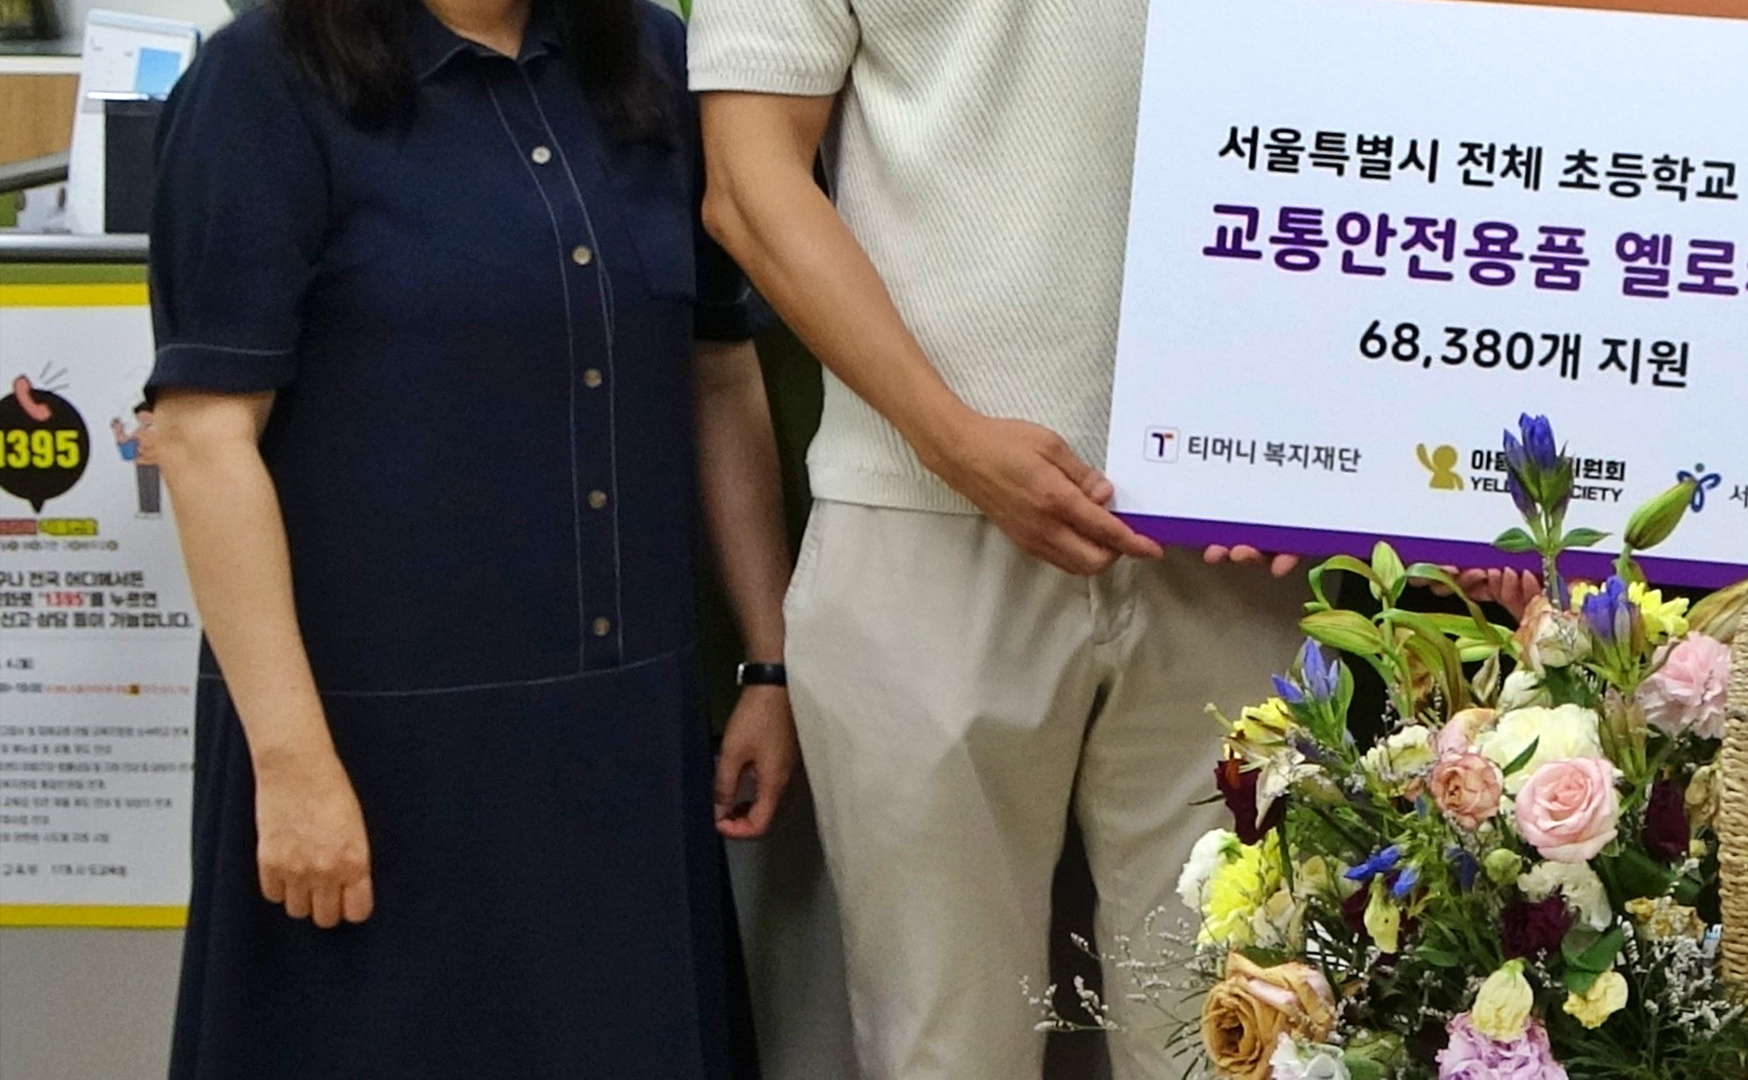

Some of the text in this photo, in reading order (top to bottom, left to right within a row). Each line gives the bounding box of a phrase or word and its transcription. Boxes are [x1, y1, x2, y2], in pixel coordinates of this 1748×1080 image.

[1217, 125, 1440, 183] 서울특별시
[1456, 141, 1542, 191] 전체
[1557, 150, 1739, 203] 초등학교
[1202, 203, 1590, 292] 교통안전용품
[1359, 320, 1690, 388] 68,380개 지원
[1188, 436, 1256, 465] 티머니
[1263, 441, 1361, 473] 복지재단
